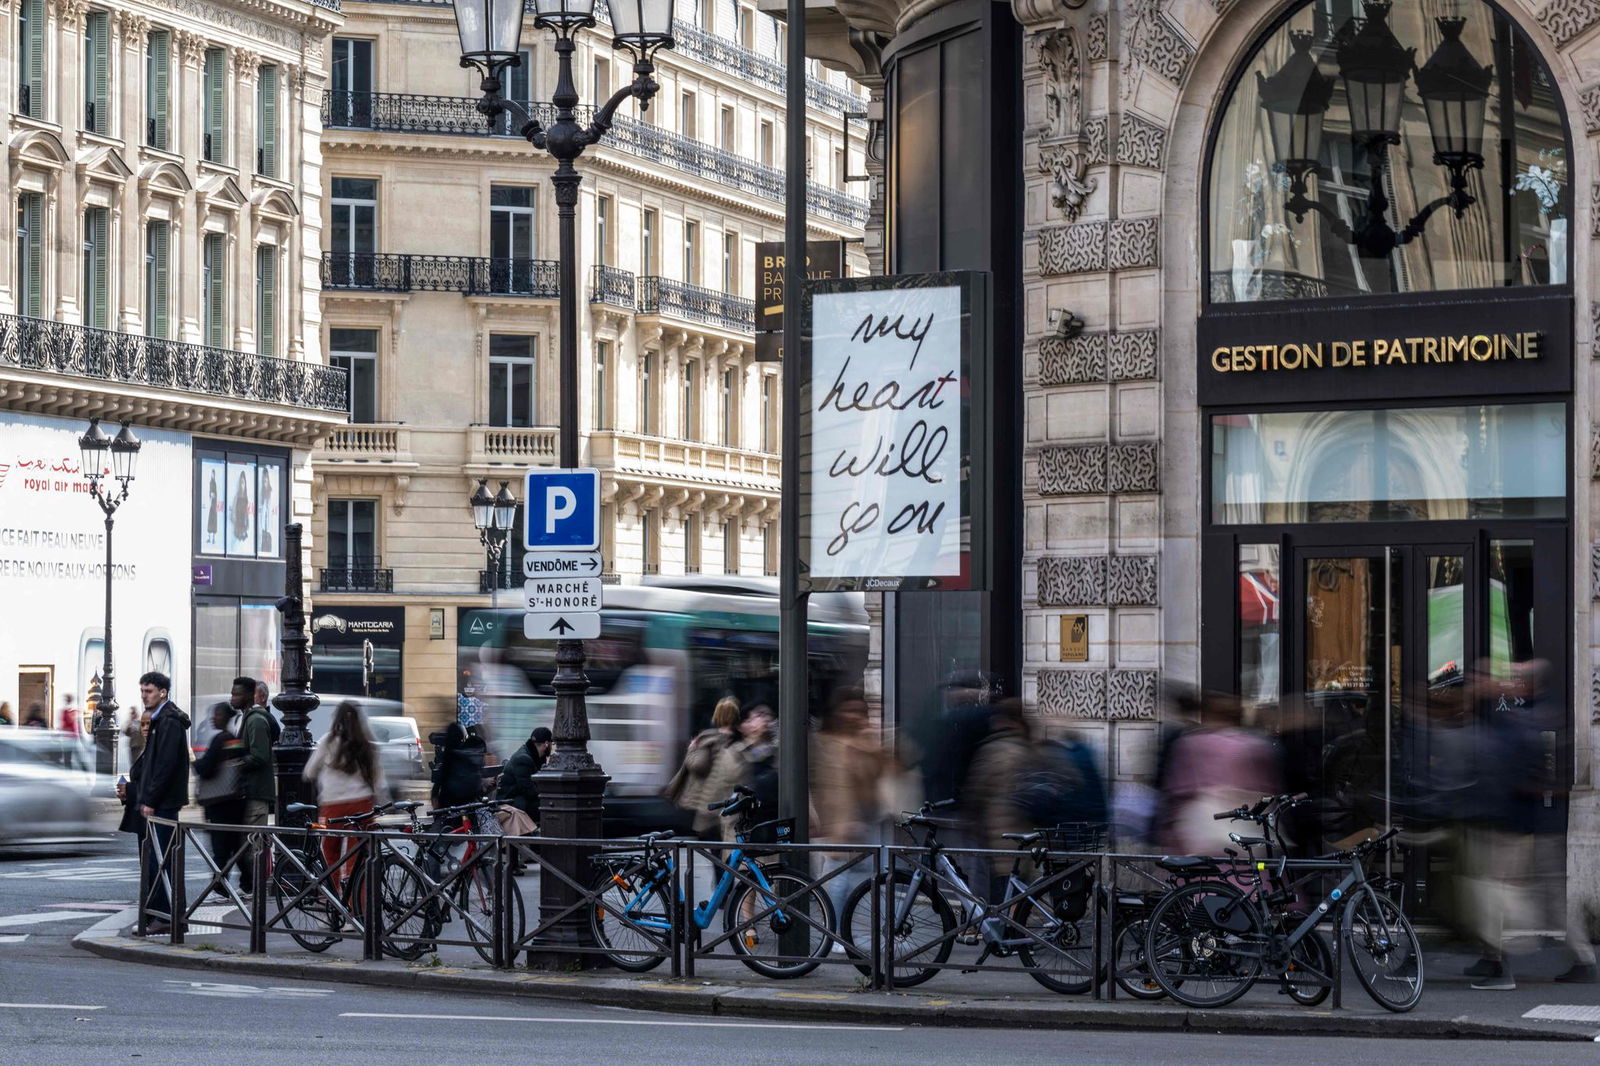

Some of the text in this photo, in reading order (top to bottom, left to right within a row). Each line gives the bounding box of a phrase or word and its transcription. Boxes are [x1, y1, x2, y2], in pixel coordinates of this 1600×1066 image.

[851, 313, 934, 370] my
[1211, 331, 1538, 373] GESTION DE PATRIMOINE
[818, 355, 957, 411] heart
[829, 420, 949, 483] will
[24, 479, 50, 491] royal
[54, 481, 68, 491] air
[545, 486, 577, 533] P
[18, 529, 40, 547] FAIT
[42, 530, 68, 549] PEAU
[70, 533, 103, 550] NEUVE
[827, 501, 945, 556] go on
[13, 560, 25, 577] DE
[28, 561, 86, 579] NOUVEAUX
[526, 558, 578, 572] VENDÔME
[536, 581, 589, 593] MARCHÉ
[865, 579, 900, 587] JCDecaux
